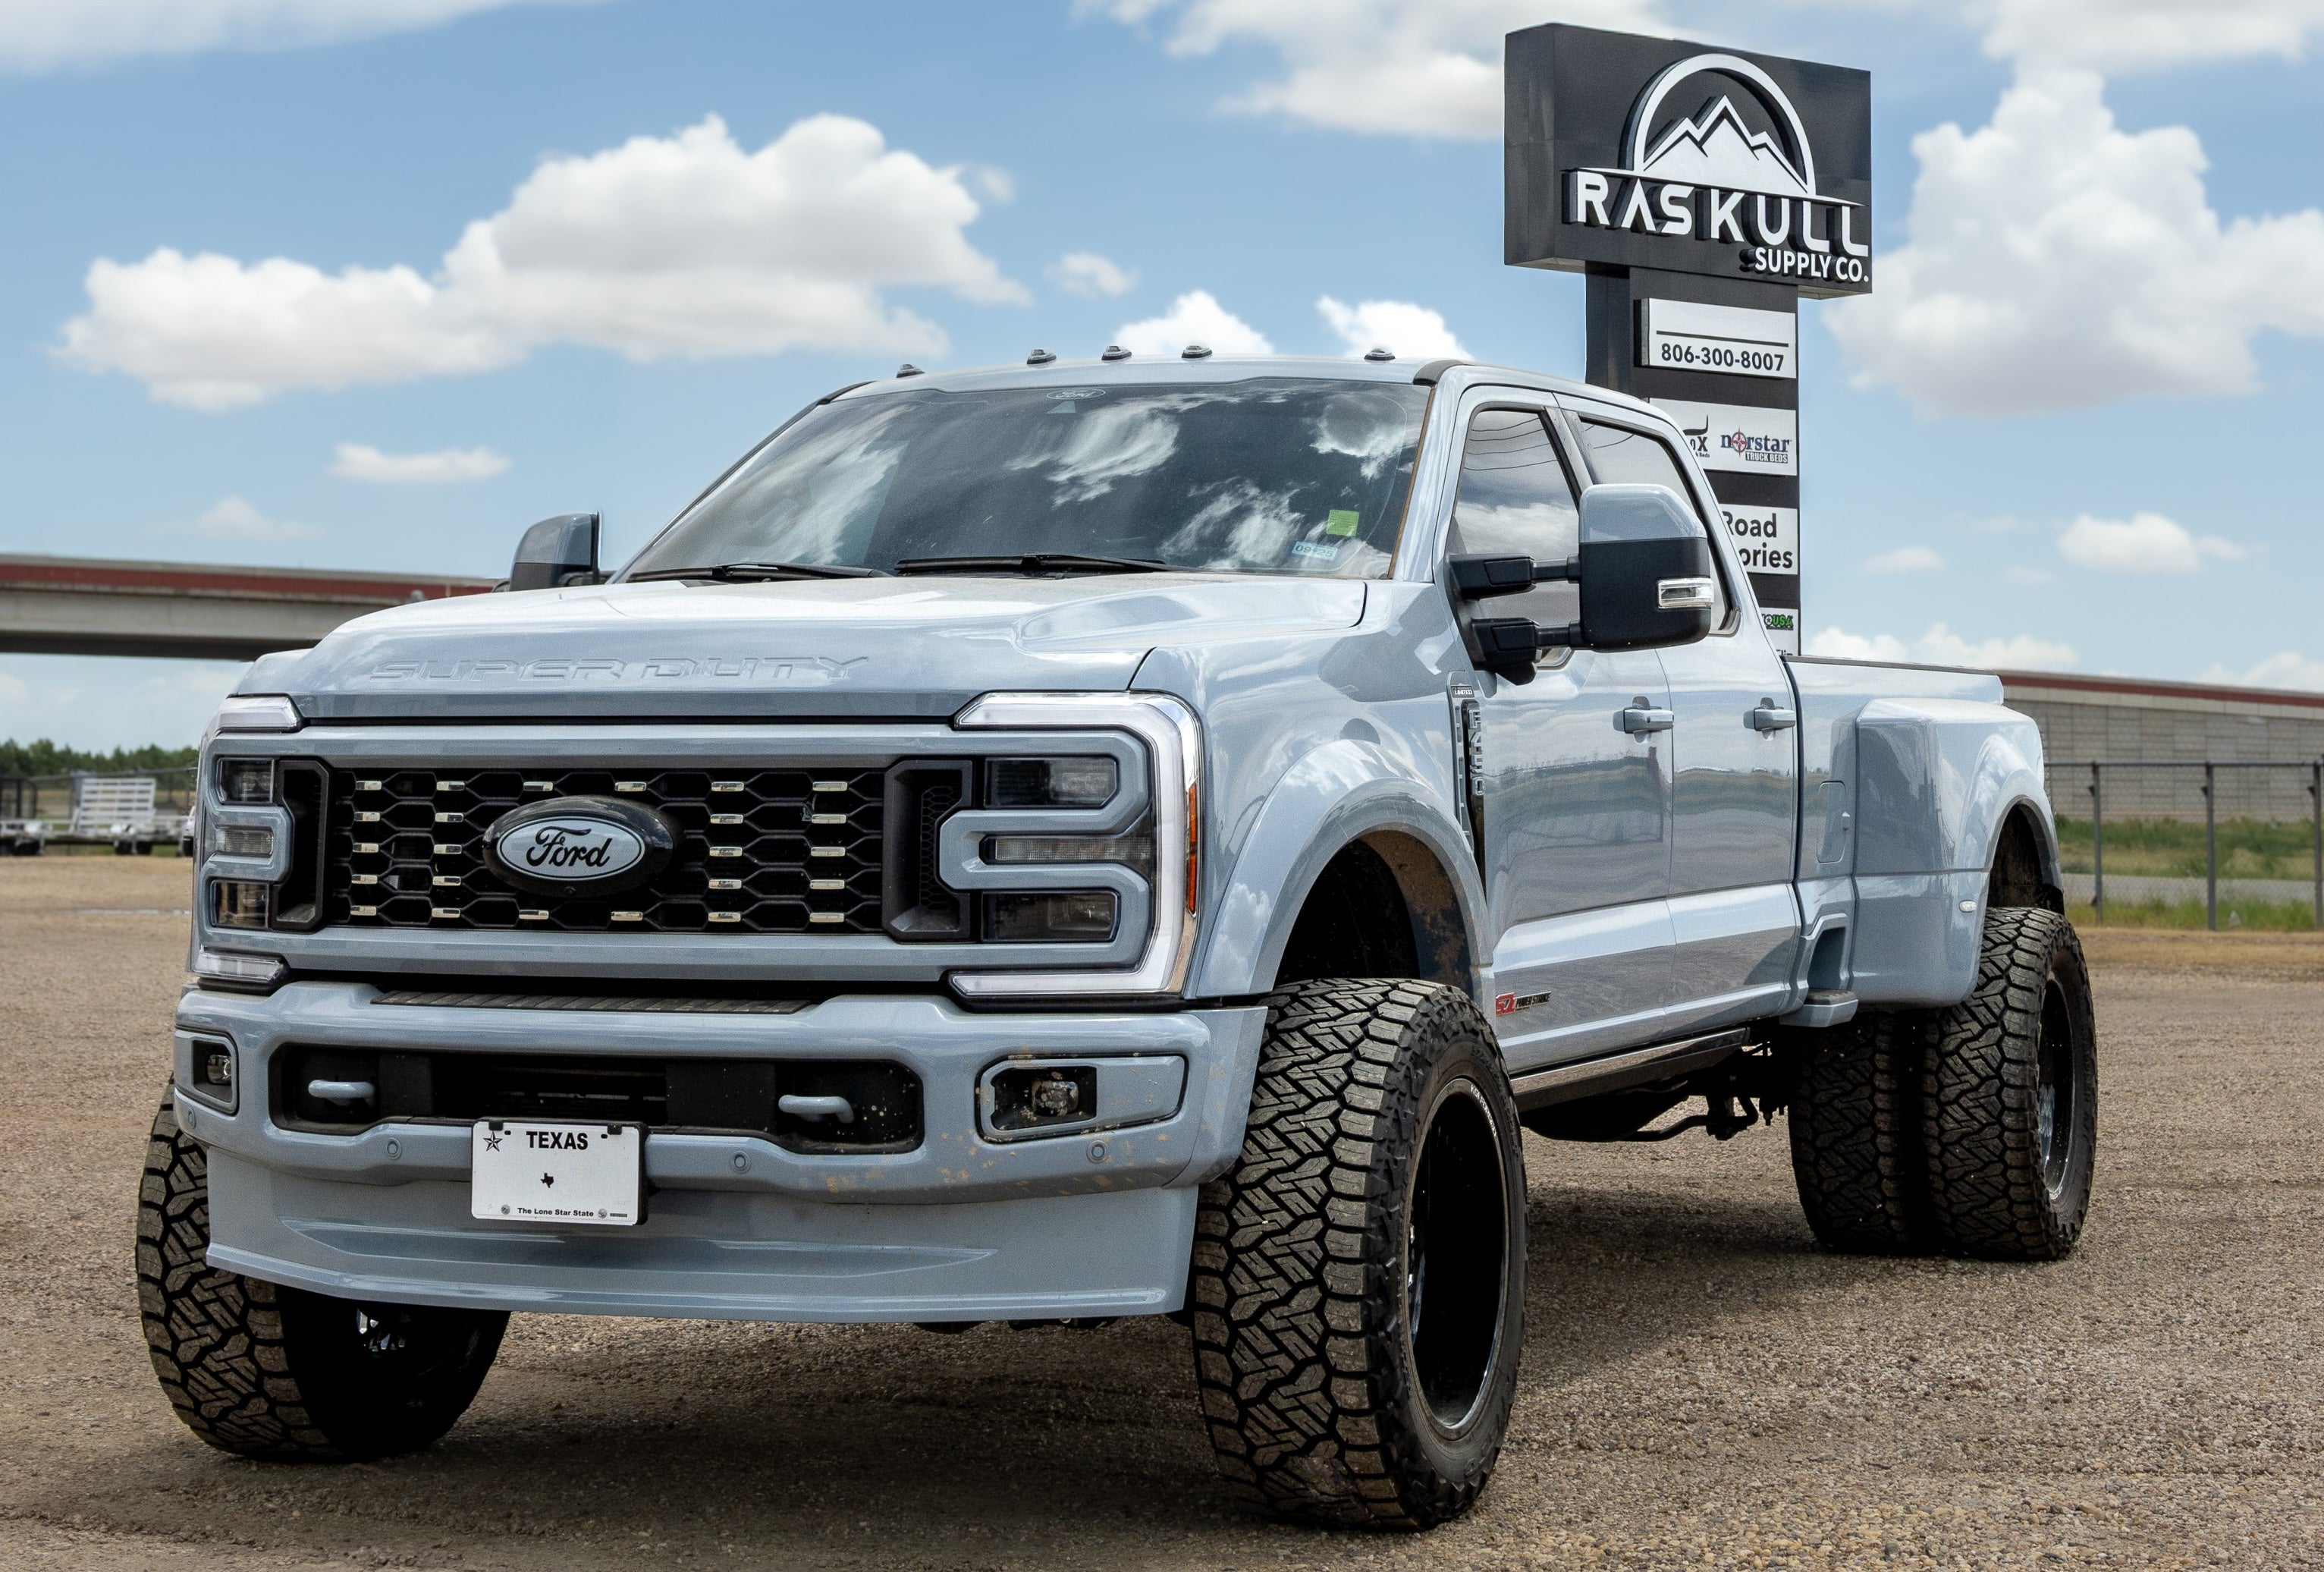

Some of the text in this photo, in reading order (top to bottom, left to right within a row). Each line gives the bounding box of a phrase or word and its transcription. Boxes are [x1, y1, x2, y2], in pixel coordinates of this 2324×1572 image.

[1576, 170, 1869, 257] RASKULL
[1754, 247, 1869, 283] SUPPLY CO.
[1661, 343, 1784, 372] 806-300-8007
[1720, 430, 1791, 454] norstar
[1745, 451, 1788, 463] TRUCK BEDS
[1295, 545, 1311, 553] 09
[369, 656, 869, 682] SUPER DUTY
[526, 825, 611, 869] Ford
[526, 1130, 589, 1150] TEXAS
